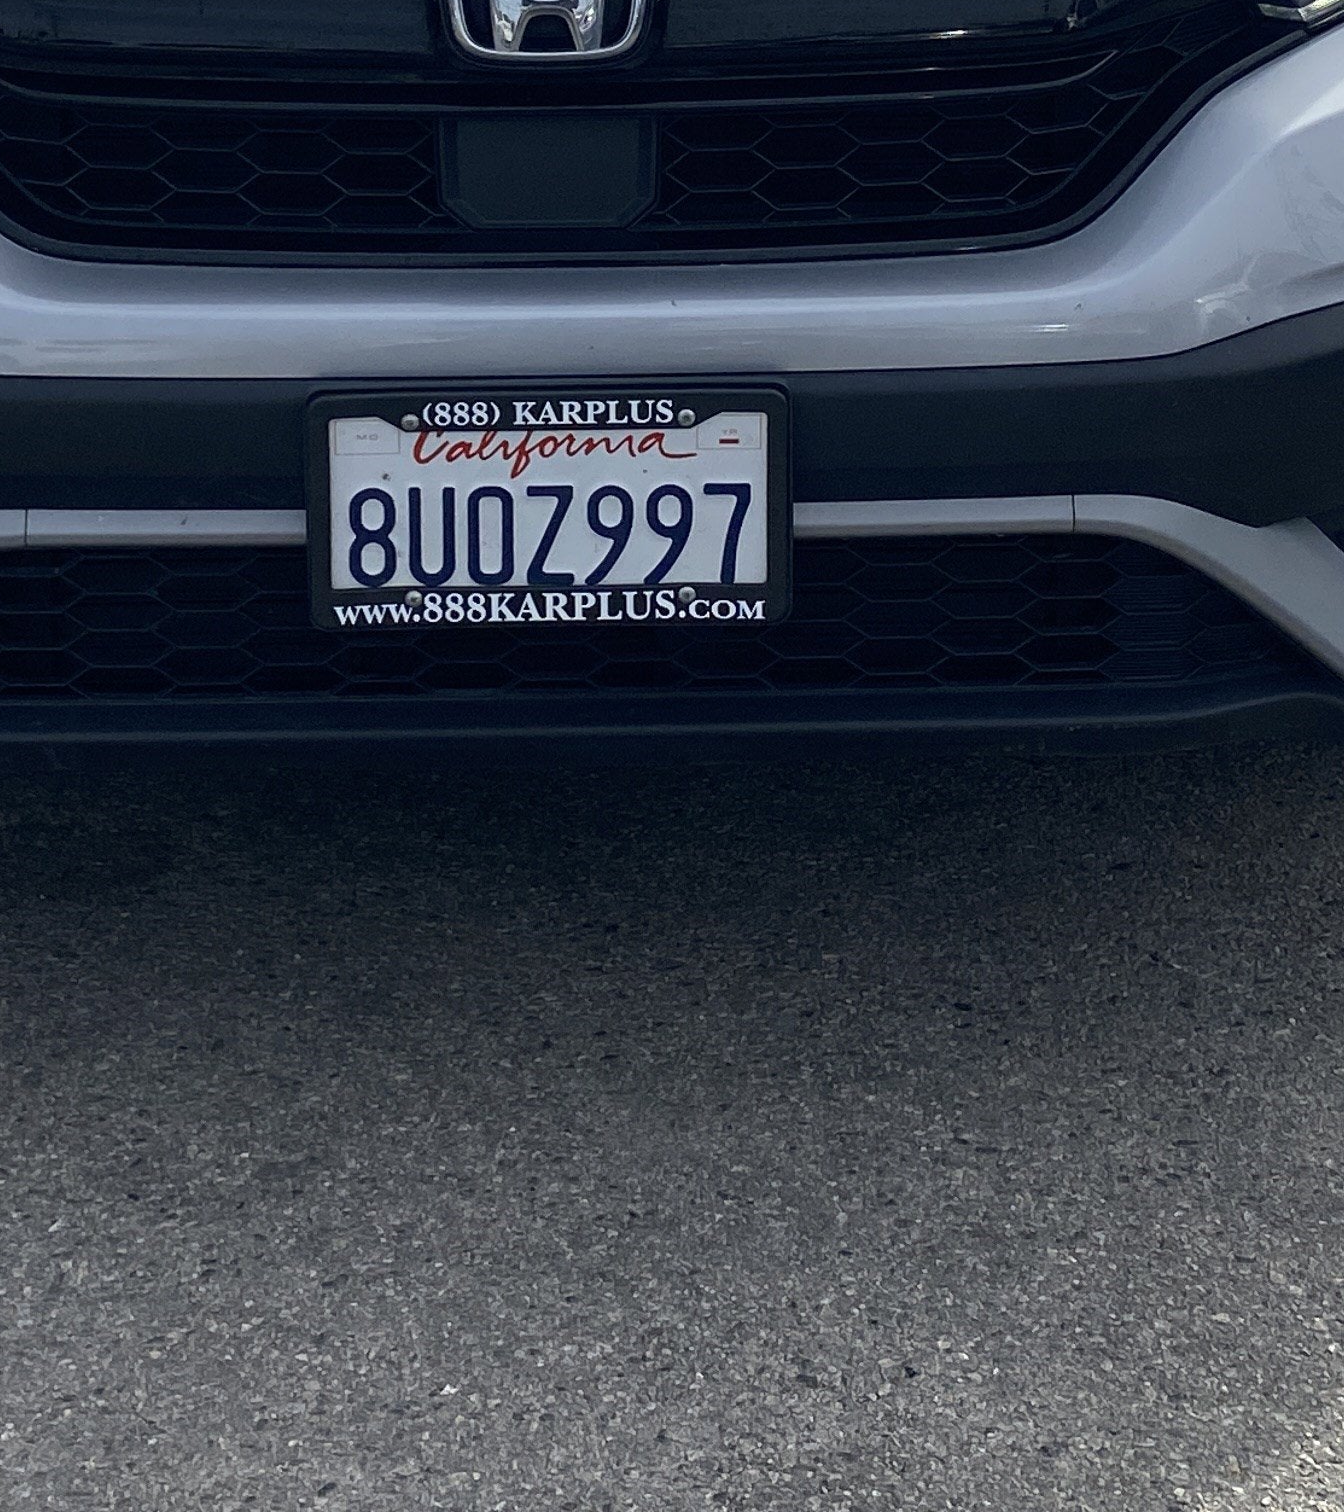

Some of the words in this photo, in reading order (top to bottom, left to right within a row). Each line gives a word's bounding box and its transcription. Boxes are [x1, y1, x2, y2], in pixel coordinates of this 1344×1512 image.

[422, 401, 500, 427] (888)
[513, 399, 674, 425] KARPLUS
[412, 430, 697, 479] California
